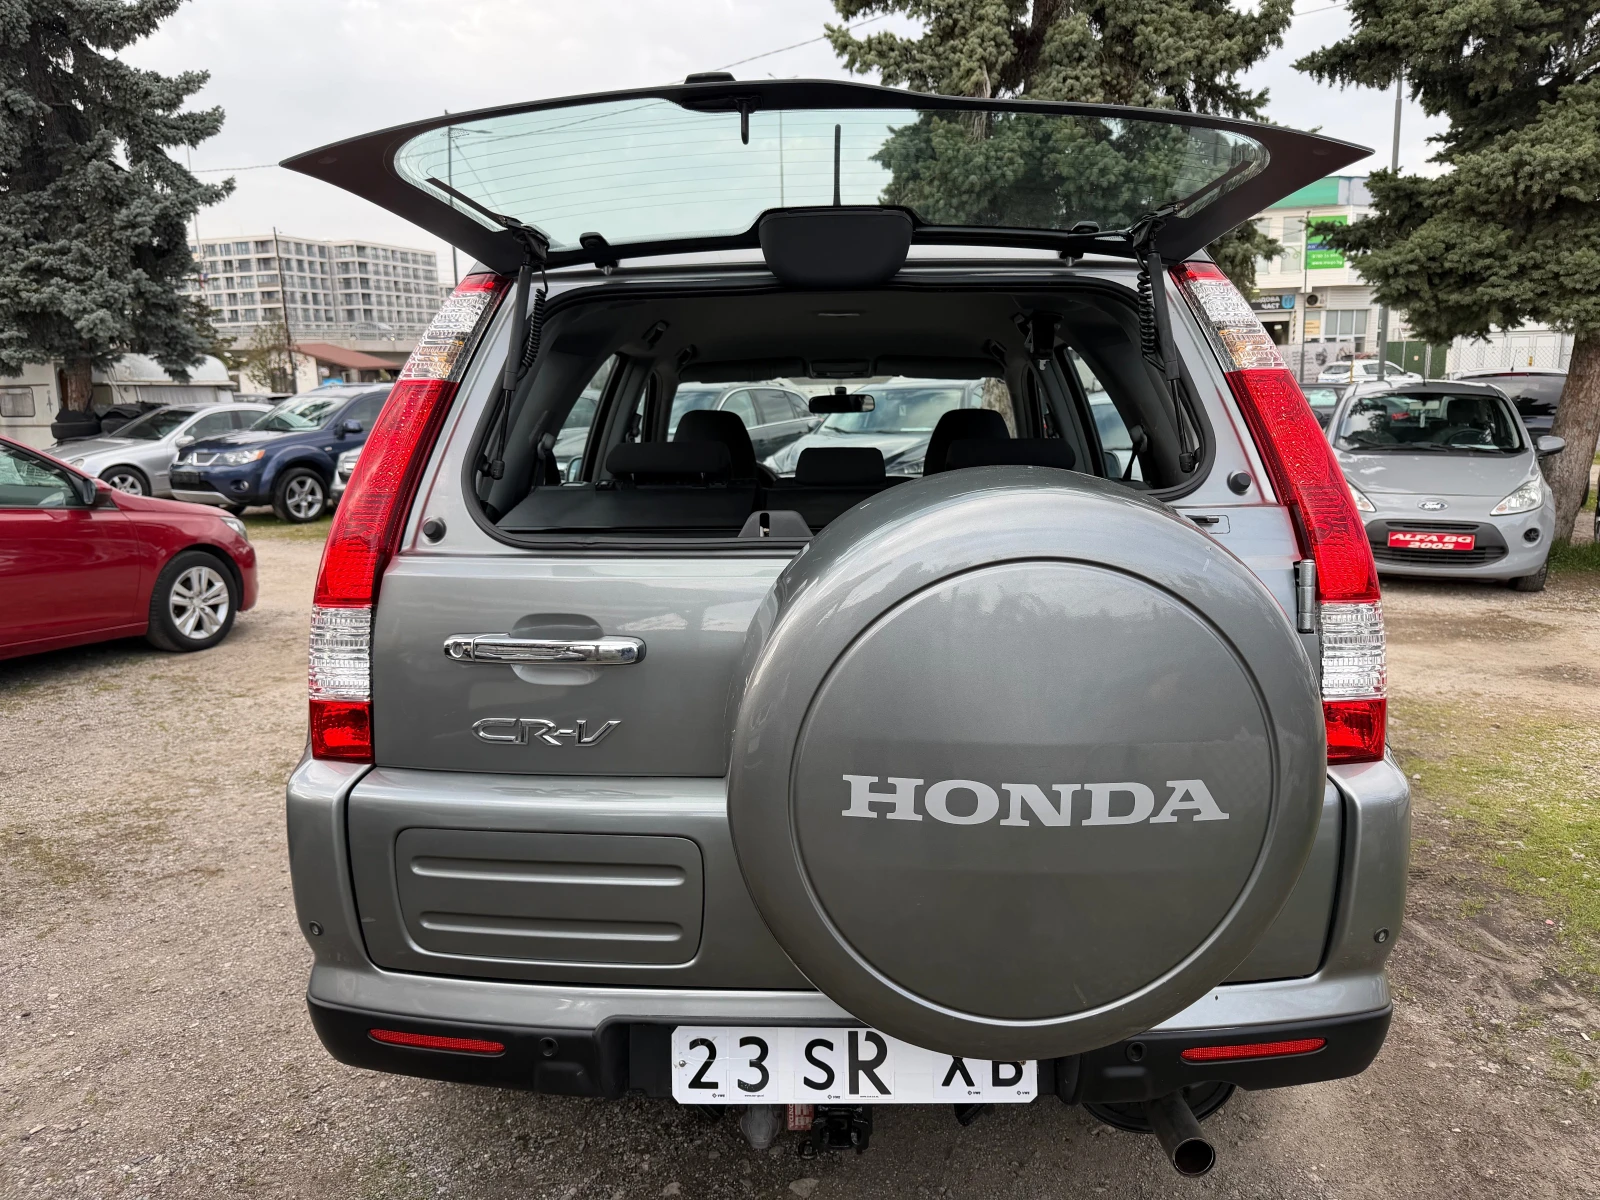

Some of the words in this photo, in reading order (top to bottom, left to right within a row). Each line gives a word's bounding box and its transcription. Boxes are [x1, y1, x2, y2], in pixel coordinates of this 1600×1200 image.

[1391, 533, 1438, 541] ALFA
[1443, 535, 1472, 543] BG
[471, 717, 622, 746] CR-V
[841, 774, 1230, 827] HONDA
[688, 1036, 770, 1092] 23
[803, 1031, 893, 1095] SR
